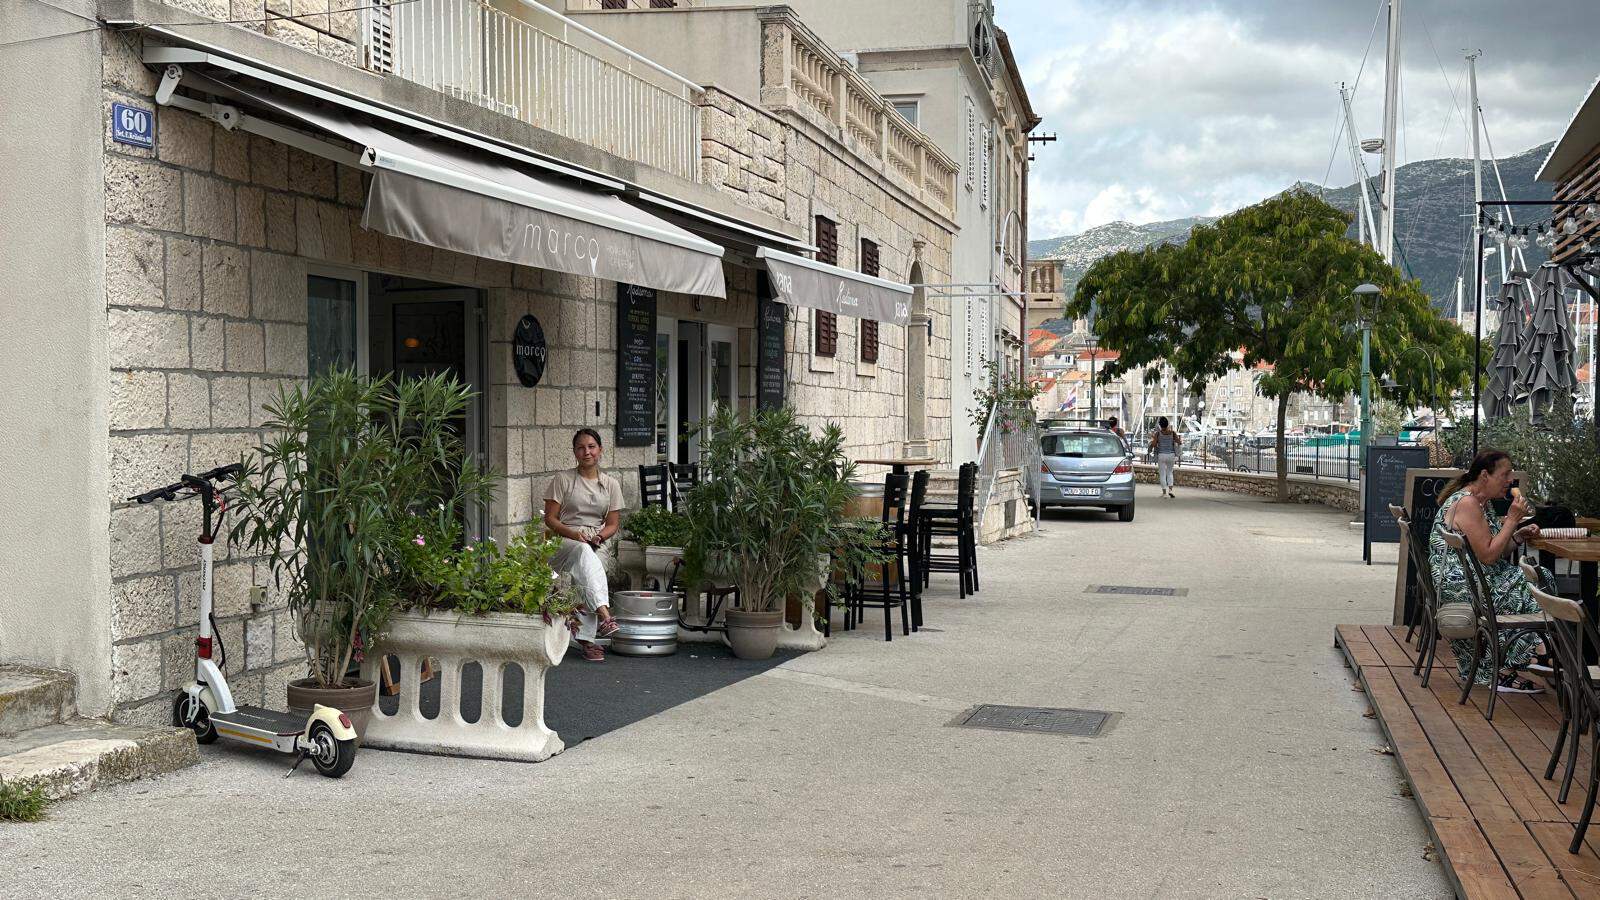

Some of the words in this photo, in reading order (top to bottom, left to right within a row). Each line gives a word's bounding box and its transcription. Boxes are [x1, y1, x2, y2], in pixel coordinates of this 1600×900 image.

[121, 109, 147, 133] 60
[523, 224, 599, 274] marco
[516, 344, 546, 362] marco
